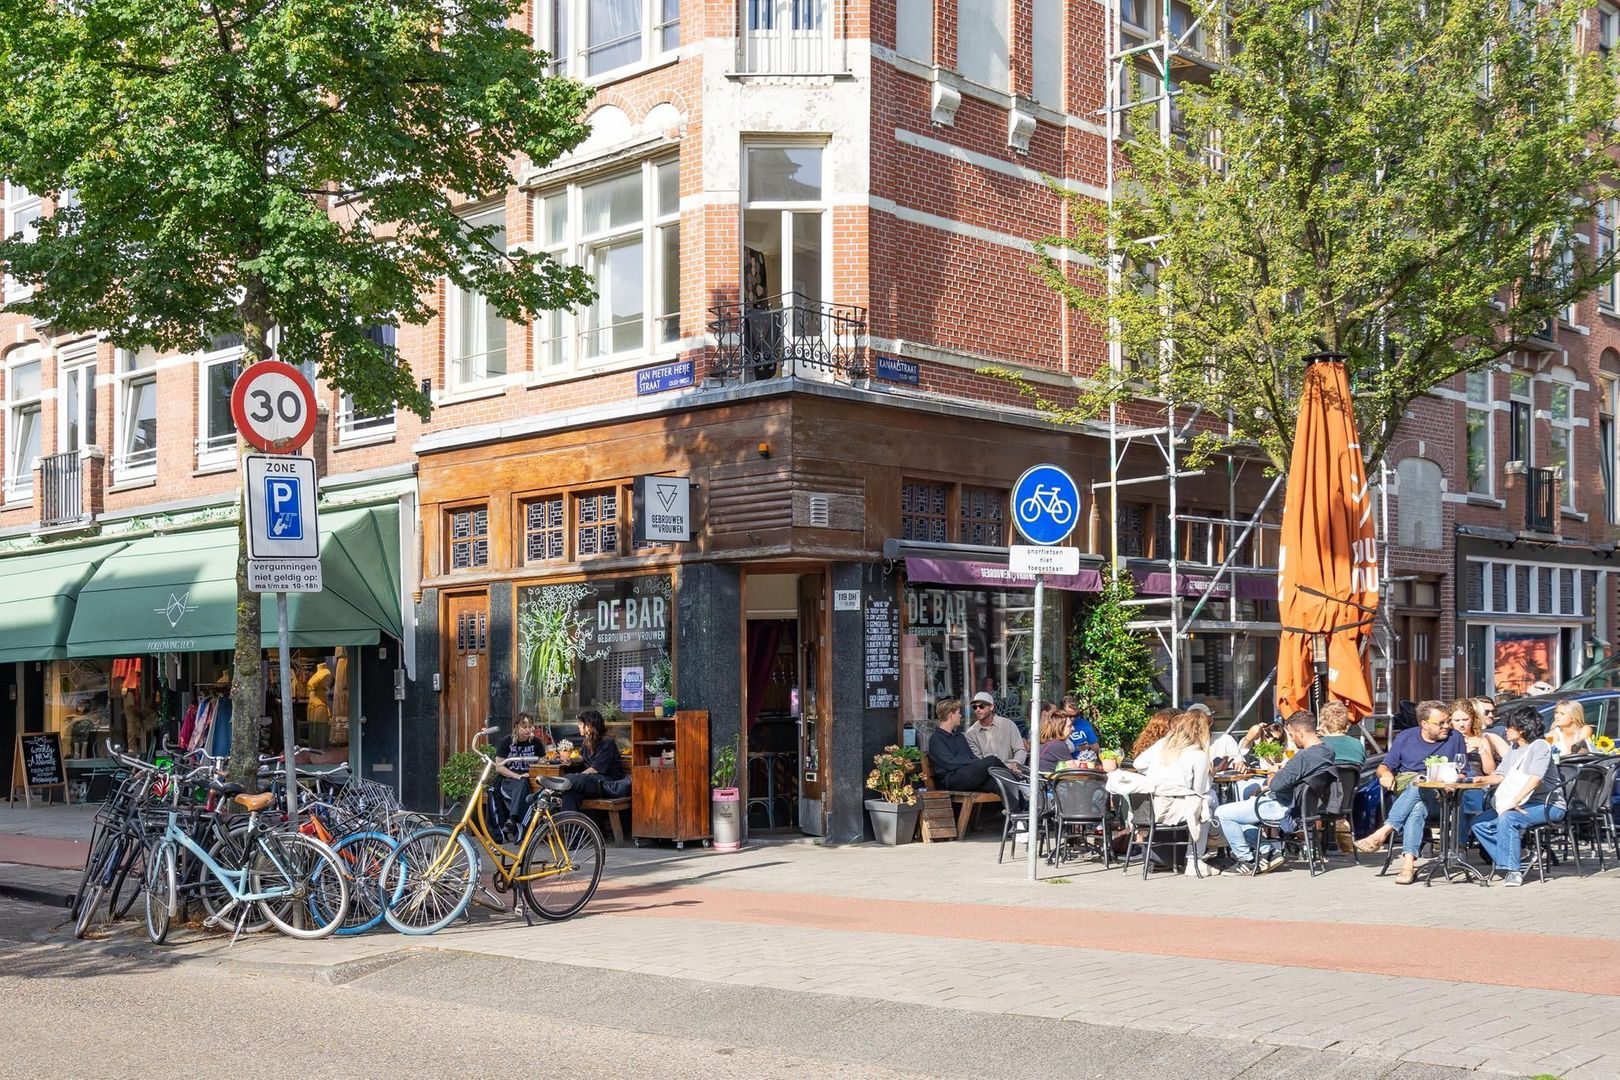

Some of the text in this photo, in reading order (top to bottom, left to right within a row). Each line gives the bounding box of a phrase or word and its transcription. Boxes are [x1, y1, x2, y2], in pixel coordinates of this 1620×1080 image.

[652, 367, 672, 378] PIETER
[640, 380, 661, 392] STRAAT
[250, 389, 302, 423] 30
[266, 463, 296, 473] ZONE
[273, 483, 293, 513] P
[652, 514, 684, 524] GEBROUWEN
[659, 524, 684, 534] VROUWEN
[254, 563, 317, 572] vergunningen
[274, 573, 301, 582] geldig
[838, 593, 848, 601] 119
[908, 591, 968, 625] DE BAR
[598, 596, 665, 631] DE BAR
[598, 630, 665, 643] GEBROUWEN VROUWEN
[1457, 646, 1464, 655] 70
